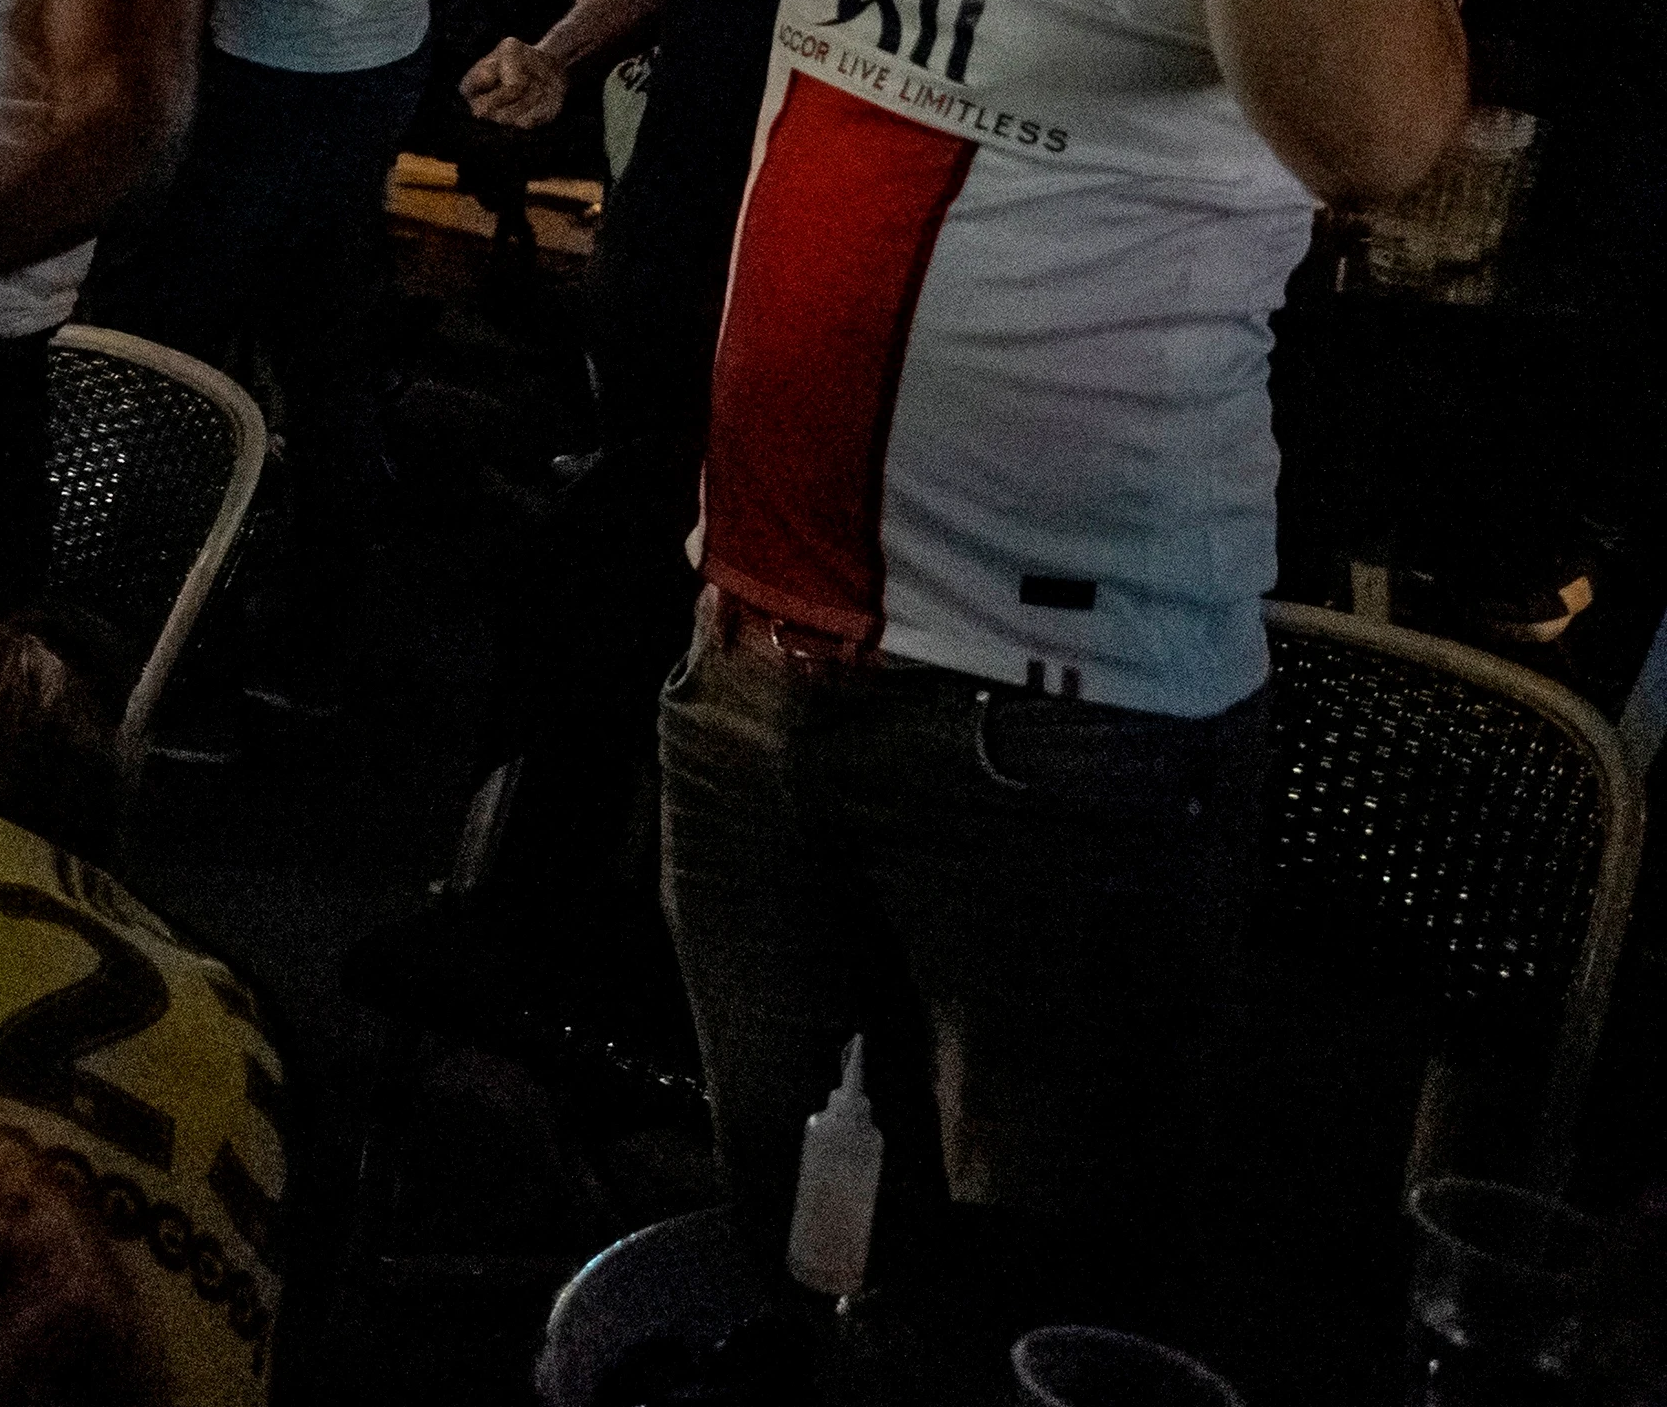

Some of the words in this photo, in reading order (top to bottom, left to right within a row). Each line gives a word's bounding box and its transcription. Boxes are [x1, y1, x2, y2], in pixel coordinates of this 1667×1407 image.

[777, 24, 831, 65] CCOR
[837, 49, 891, 92] LIVE
[898, 77, 1069, 153] LIMITLESS
